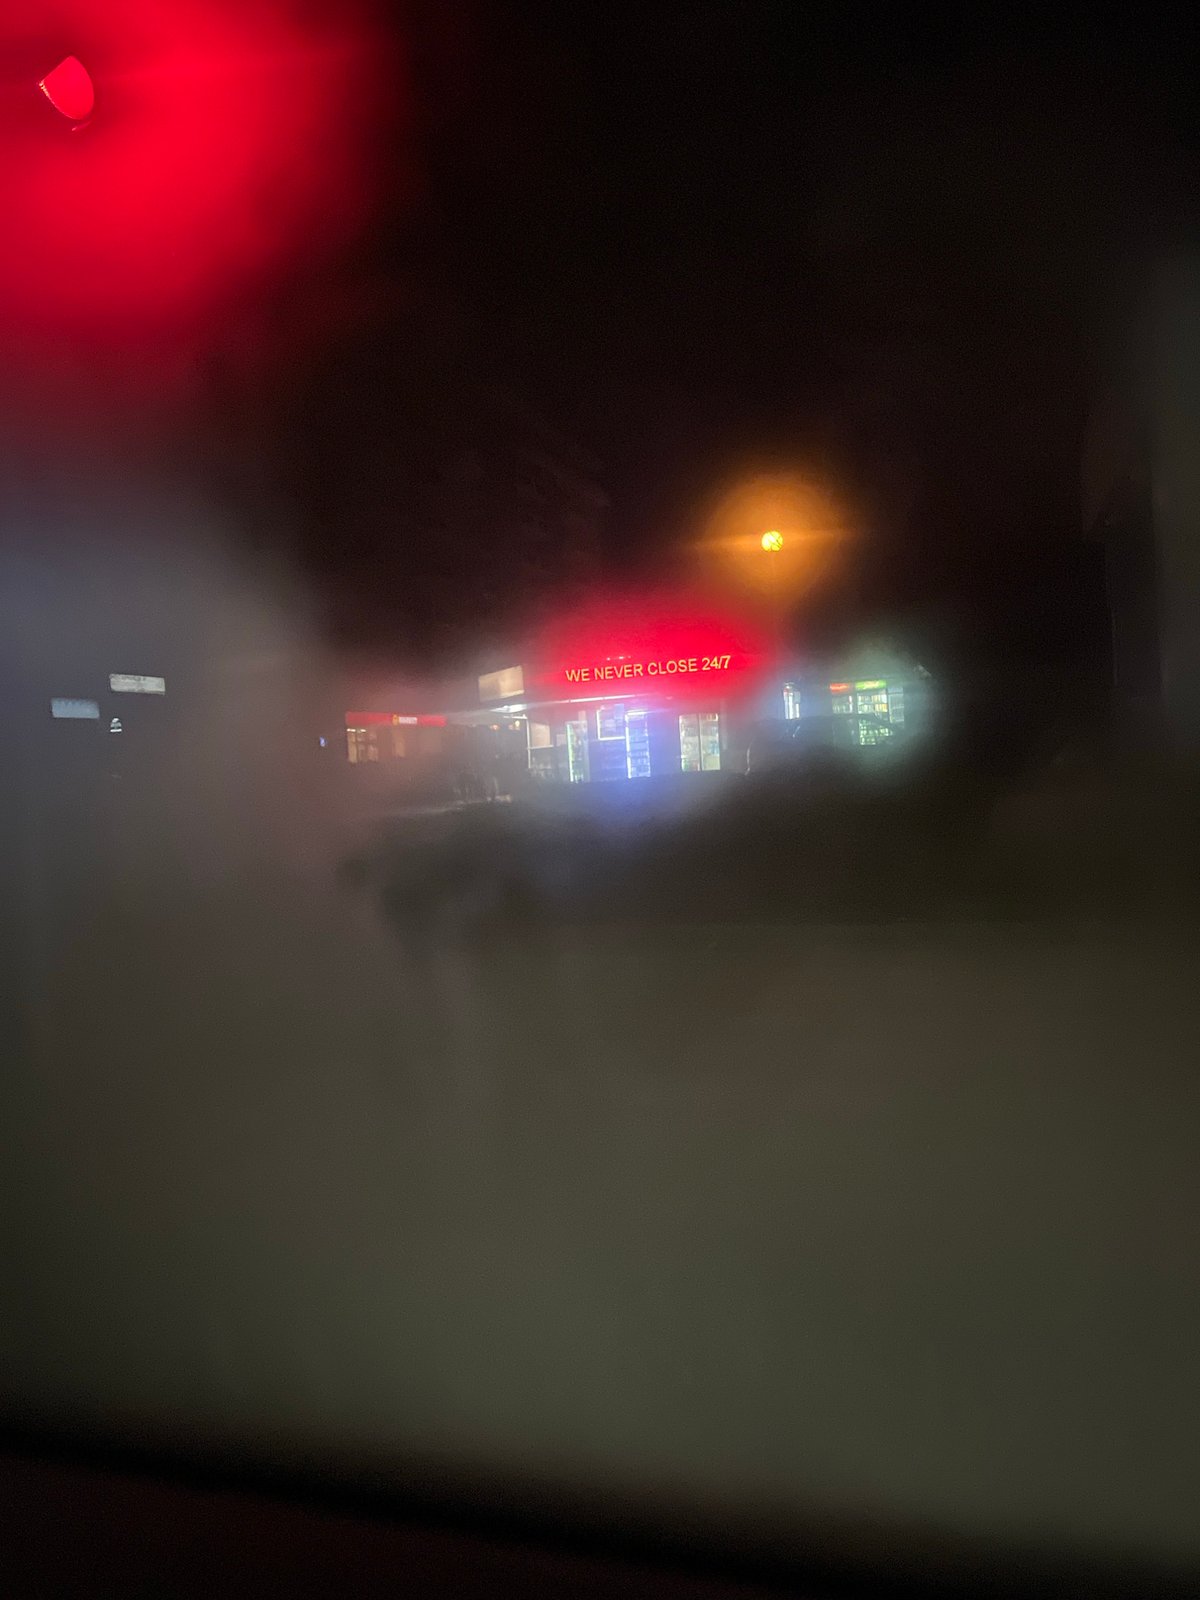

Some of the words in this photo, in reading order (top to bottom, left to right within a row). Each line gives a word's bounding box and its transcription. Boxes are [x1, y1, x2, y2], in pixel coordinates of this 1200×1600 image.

[565, 668, 590, 682] WE
[594, 663, 644, 680] NEVER
[647, 658, 698, 675] CLOSE
[701, 655, 731, 671] 24/7
